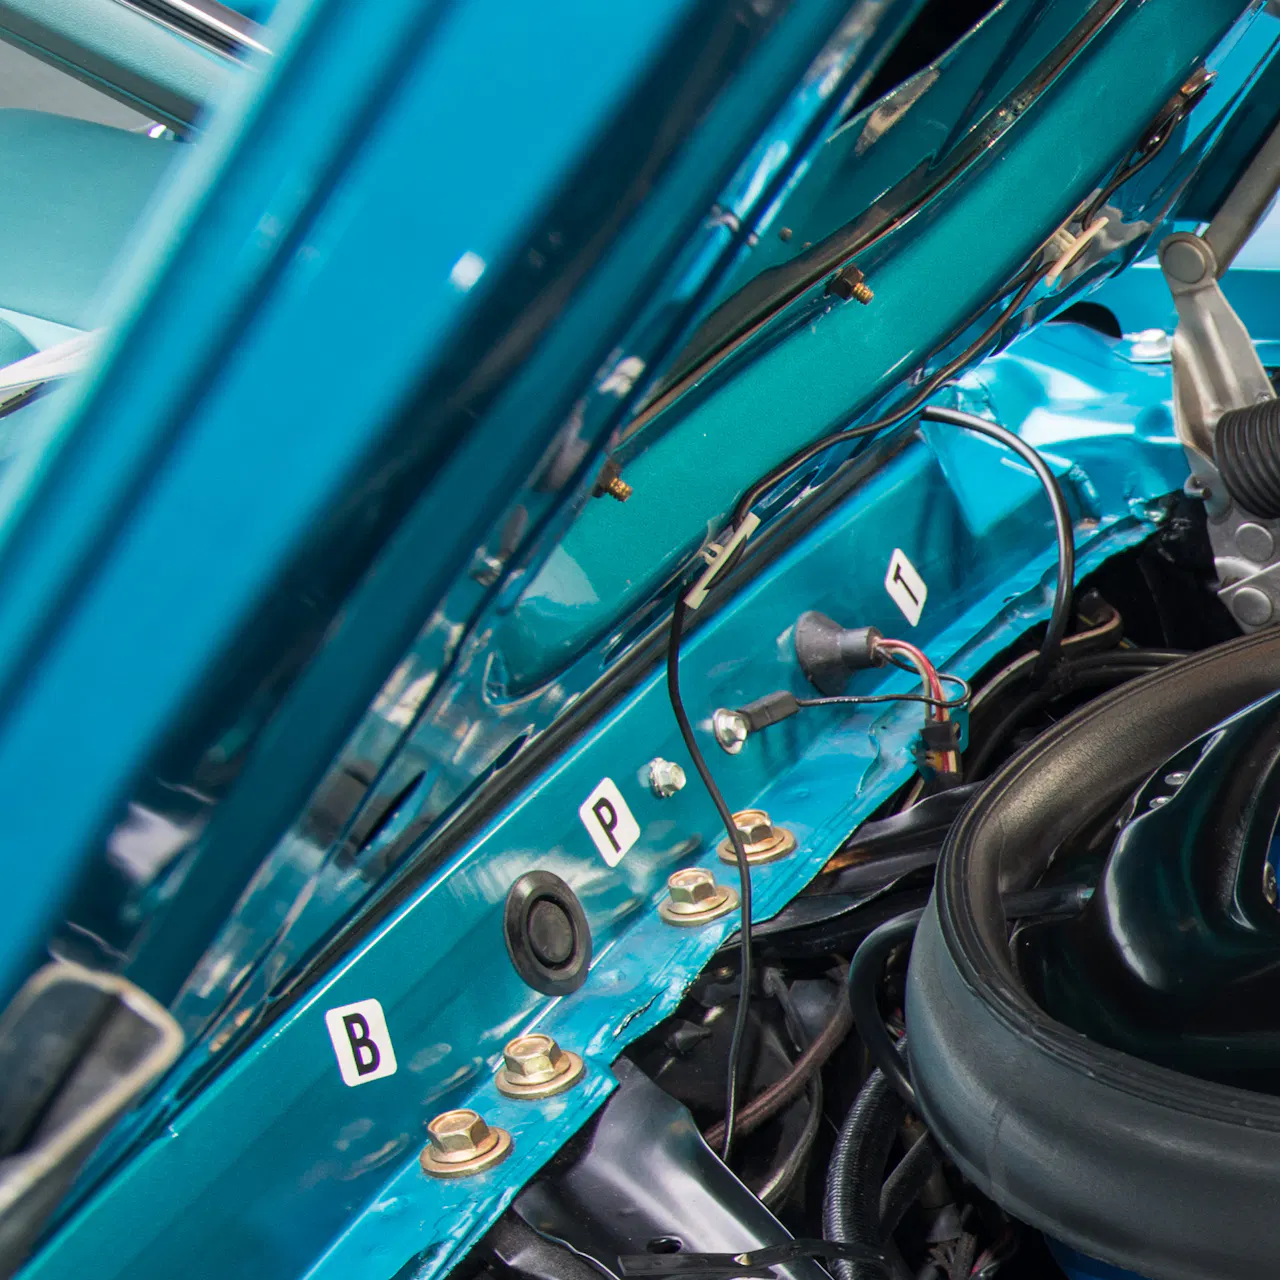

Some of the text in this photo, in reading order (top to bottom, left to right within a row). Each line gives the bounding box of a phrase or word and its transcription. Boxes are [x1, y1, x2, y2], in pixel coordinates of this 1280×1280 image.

[892, 562, 917, 606] T
[591, 797, 622, 854] P
[342, 1011, 382, 1077] B
